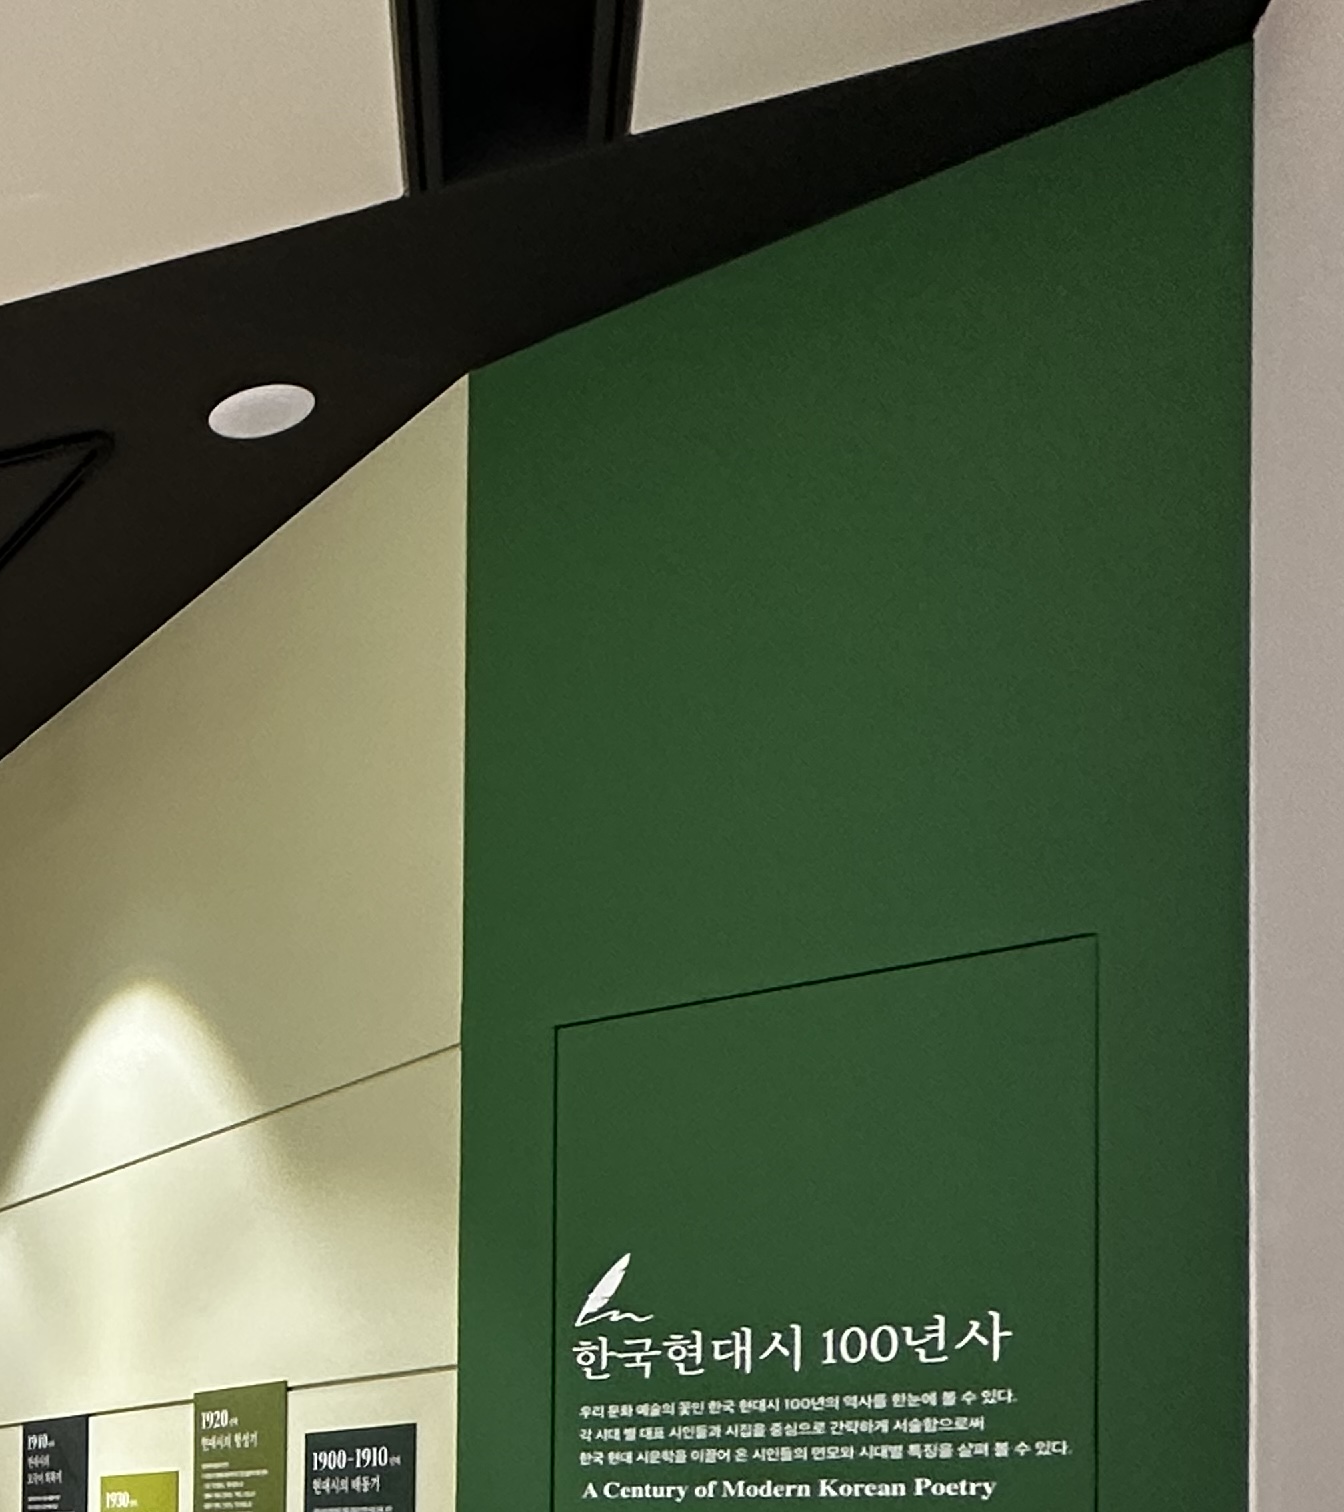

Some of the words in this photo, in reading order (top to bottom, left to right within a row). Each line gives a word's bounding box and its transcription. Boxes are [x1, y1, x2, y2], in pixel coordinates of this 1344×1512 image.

[573, 1324, 802, 1380] 한국현대시
[821, 1310, 1012, 1365] 100년사
[579, 1405, 604, 1419] 우리
[608, 1405, 633, 1418] 문화
[636, 1403, 675, 1417] 예술의
[679, 1401, 704, 1416] 꽃인
[708, 1400, 735, 1414] 한국
[739, 1398, 779, 1413] 현대시
[785, 1396, 839, 1411] 100년의
[843, 1393, 887, 1409] 역사를
[892, 1391, 937, 1407] 한눈에
[942, 1391, 956, 1406] 볼
[961, 1391, 977, 1405] 수
[981, 1389, 1017, 1404] 있다.
[579, 1429, 592, 1442] 각
[595, 1428, 620, 1441] 시대
[639, 1427, 664, 1440] 대표
[669, 1425, 721, 1439] 시인들과
[725, 1423, 765, 1438] 시집을
[770, 1421, 825, 1437] 중심으로
[830, 1419, 889, 1435] 간략하게
[893, 1416, 984, 1433] 서술함으로써
[580, 1452, 603, 1465] 한국
[608, 1451, 633, 1465] 현대
[636, 1449, 687, 1463] 시문학을
[691, 1449, 730, 1463] 이끌어
[735, 1448, 748, 1462] 온
[752, 1447, 807, 1461] 시인들의
[859, 1445, 903, 1459] 시대별
[957, 1443, 989, 1457] 살펴
[995, 1442, 1009, 1457] 볼
[1015, 1441, 1031, 1456] 수
[1035, 1441, 1073, 1455] 있다.
[583, 1483, 598, 1498] A
[603, 1482, 687, 1502] Century
[695, 1481, 717, 1497] of
[722, 1480, 810, 1497] Modern
[819, 1479, 905, 1497] Korean
[915, 1478, 996, 1500] Poetry
